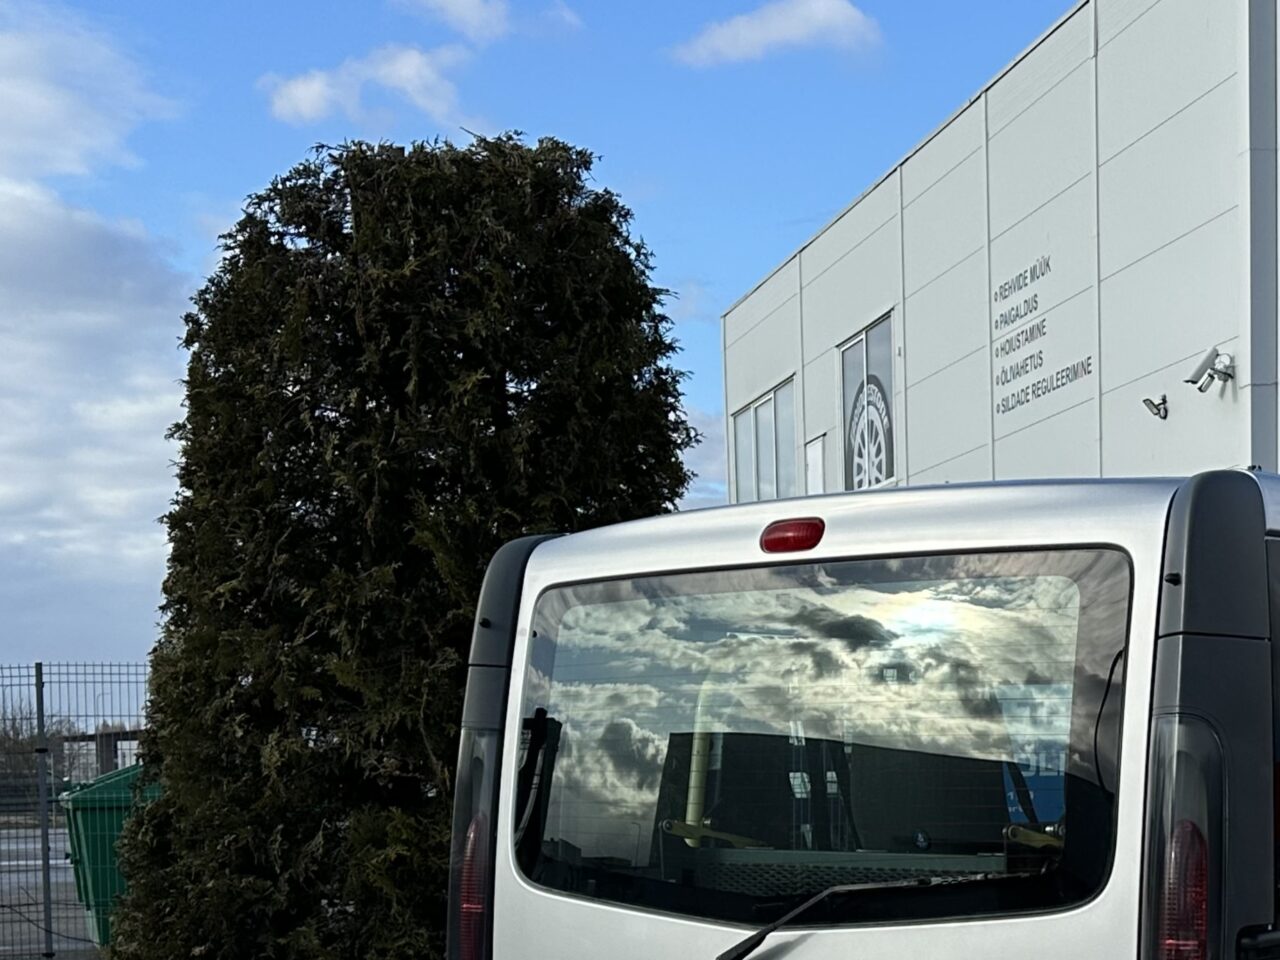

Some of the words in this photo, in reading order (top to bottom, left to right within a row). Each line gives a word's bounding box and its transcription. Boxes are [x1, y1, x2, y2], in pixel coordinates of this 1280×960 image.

[999, 269, 1028, 301] REHVIDE
[1030, 255, 1051, 283] MÜÜK
[999, 293, 1038, 330] PAIGALDUS
[1001, 385, 1030, 414] SILDADE
[1031, 356, 1092, 400] REGULEERIMINE
